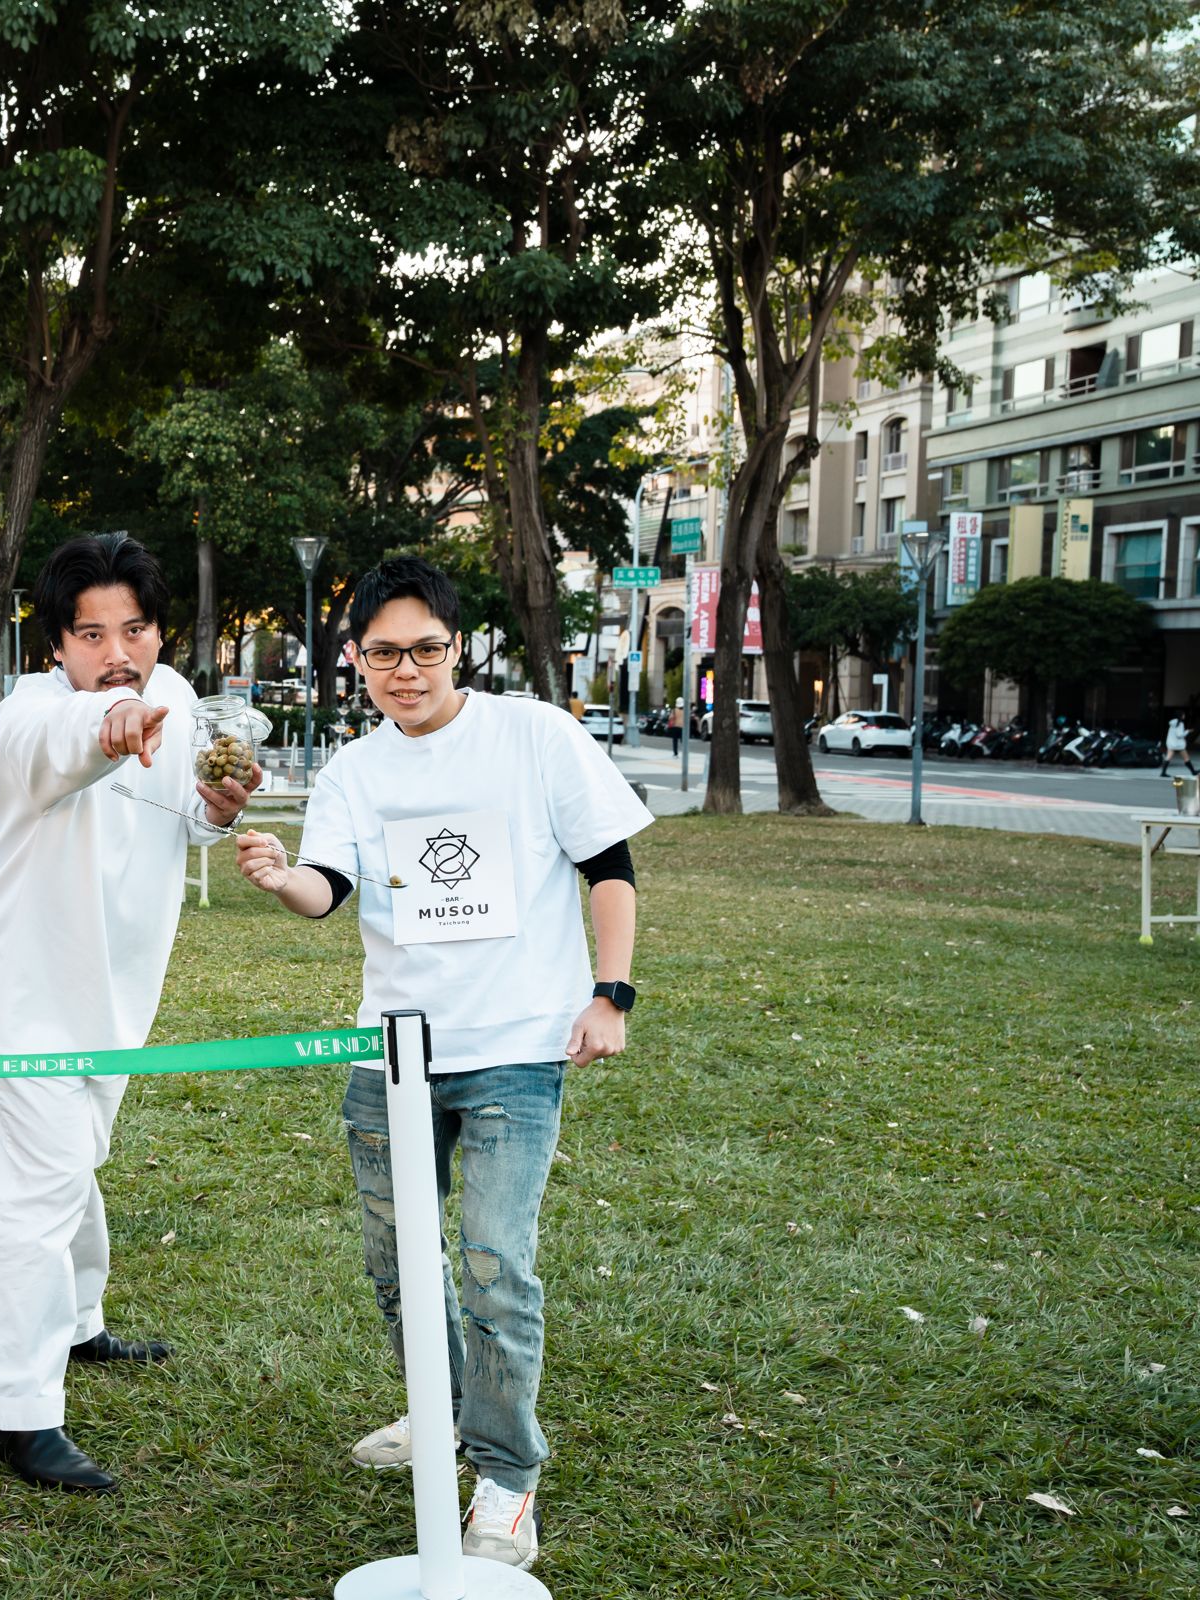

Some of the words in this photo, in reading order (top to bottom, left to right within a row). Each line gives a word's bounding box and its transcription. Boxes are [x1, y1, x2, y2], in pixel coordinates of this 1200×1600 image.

[957, 516, 978, 535] 租售
[418, 903, 489, 919] MUSOU
[294, 1035, 384, 1057] VENDE
